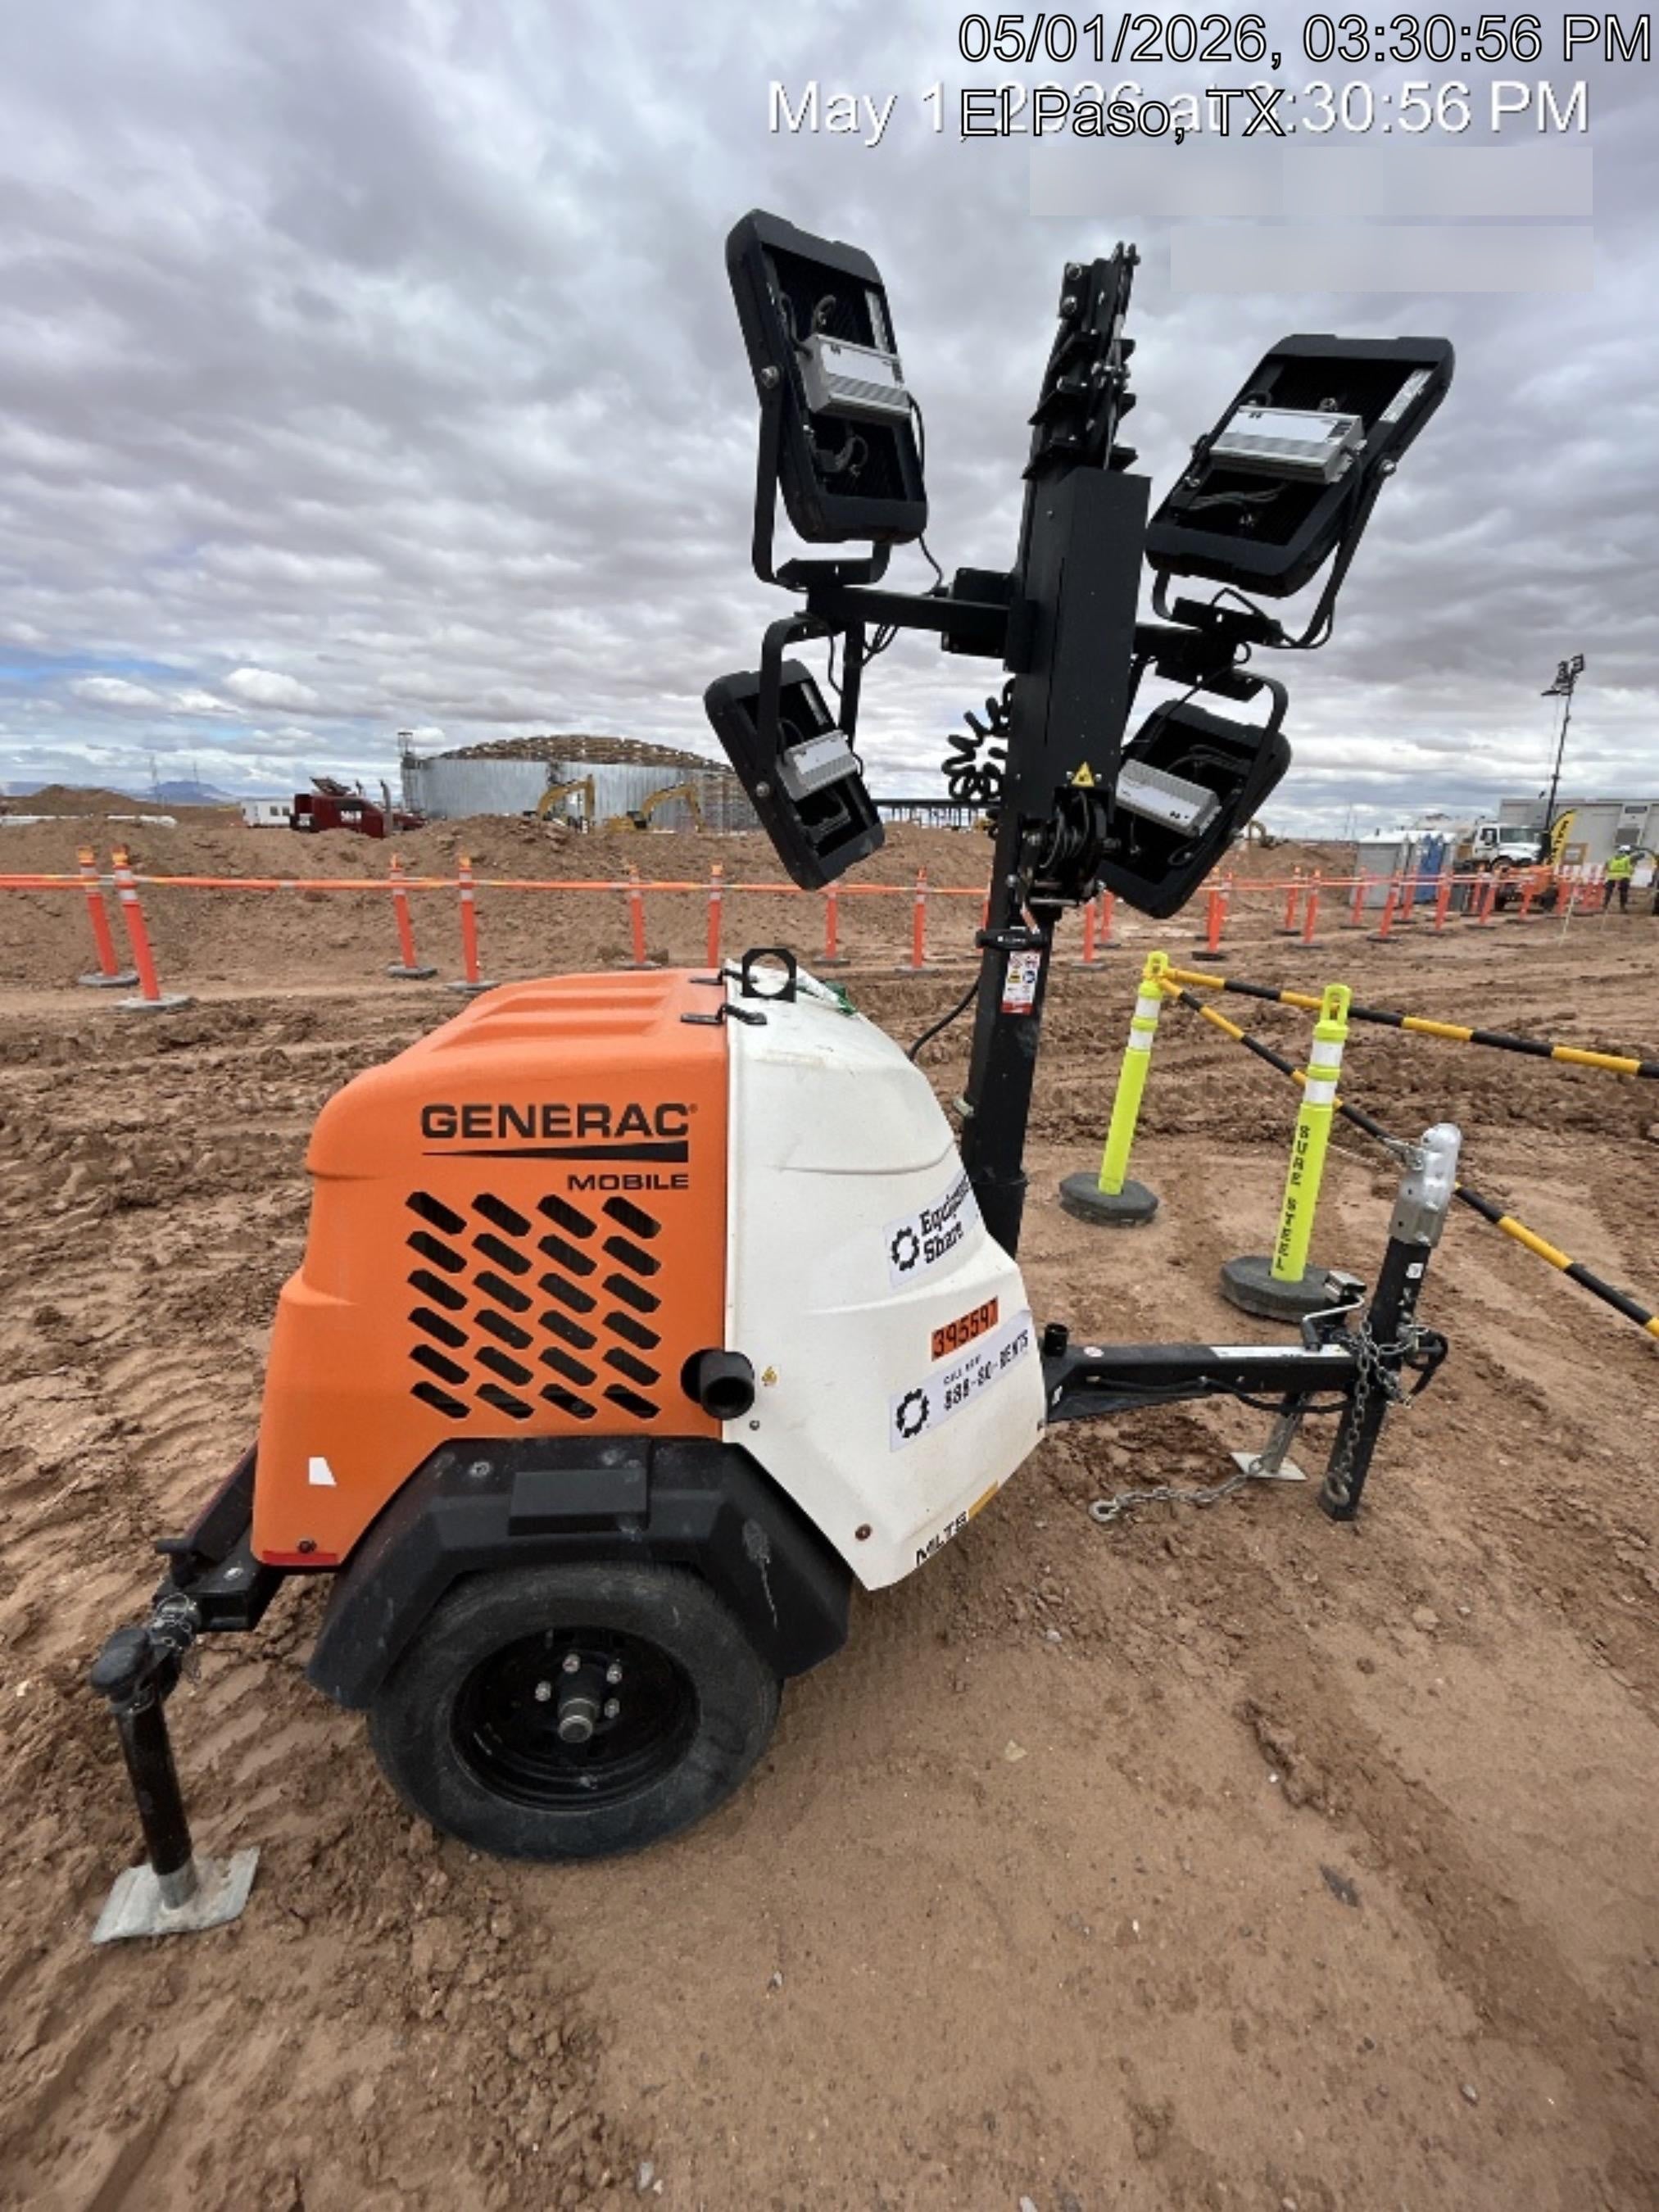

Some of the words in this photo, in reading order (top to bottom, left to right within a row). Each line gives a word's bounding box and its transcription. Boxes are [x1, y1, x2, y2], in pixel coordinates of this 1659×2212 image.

[421, 1103, 689, 1139] GENERAC
[1290, 1125, 1310, 1185] SURE
[567, 1173, 689, 1190] MOBILE
[923, 1222, 963, 1263] Share
